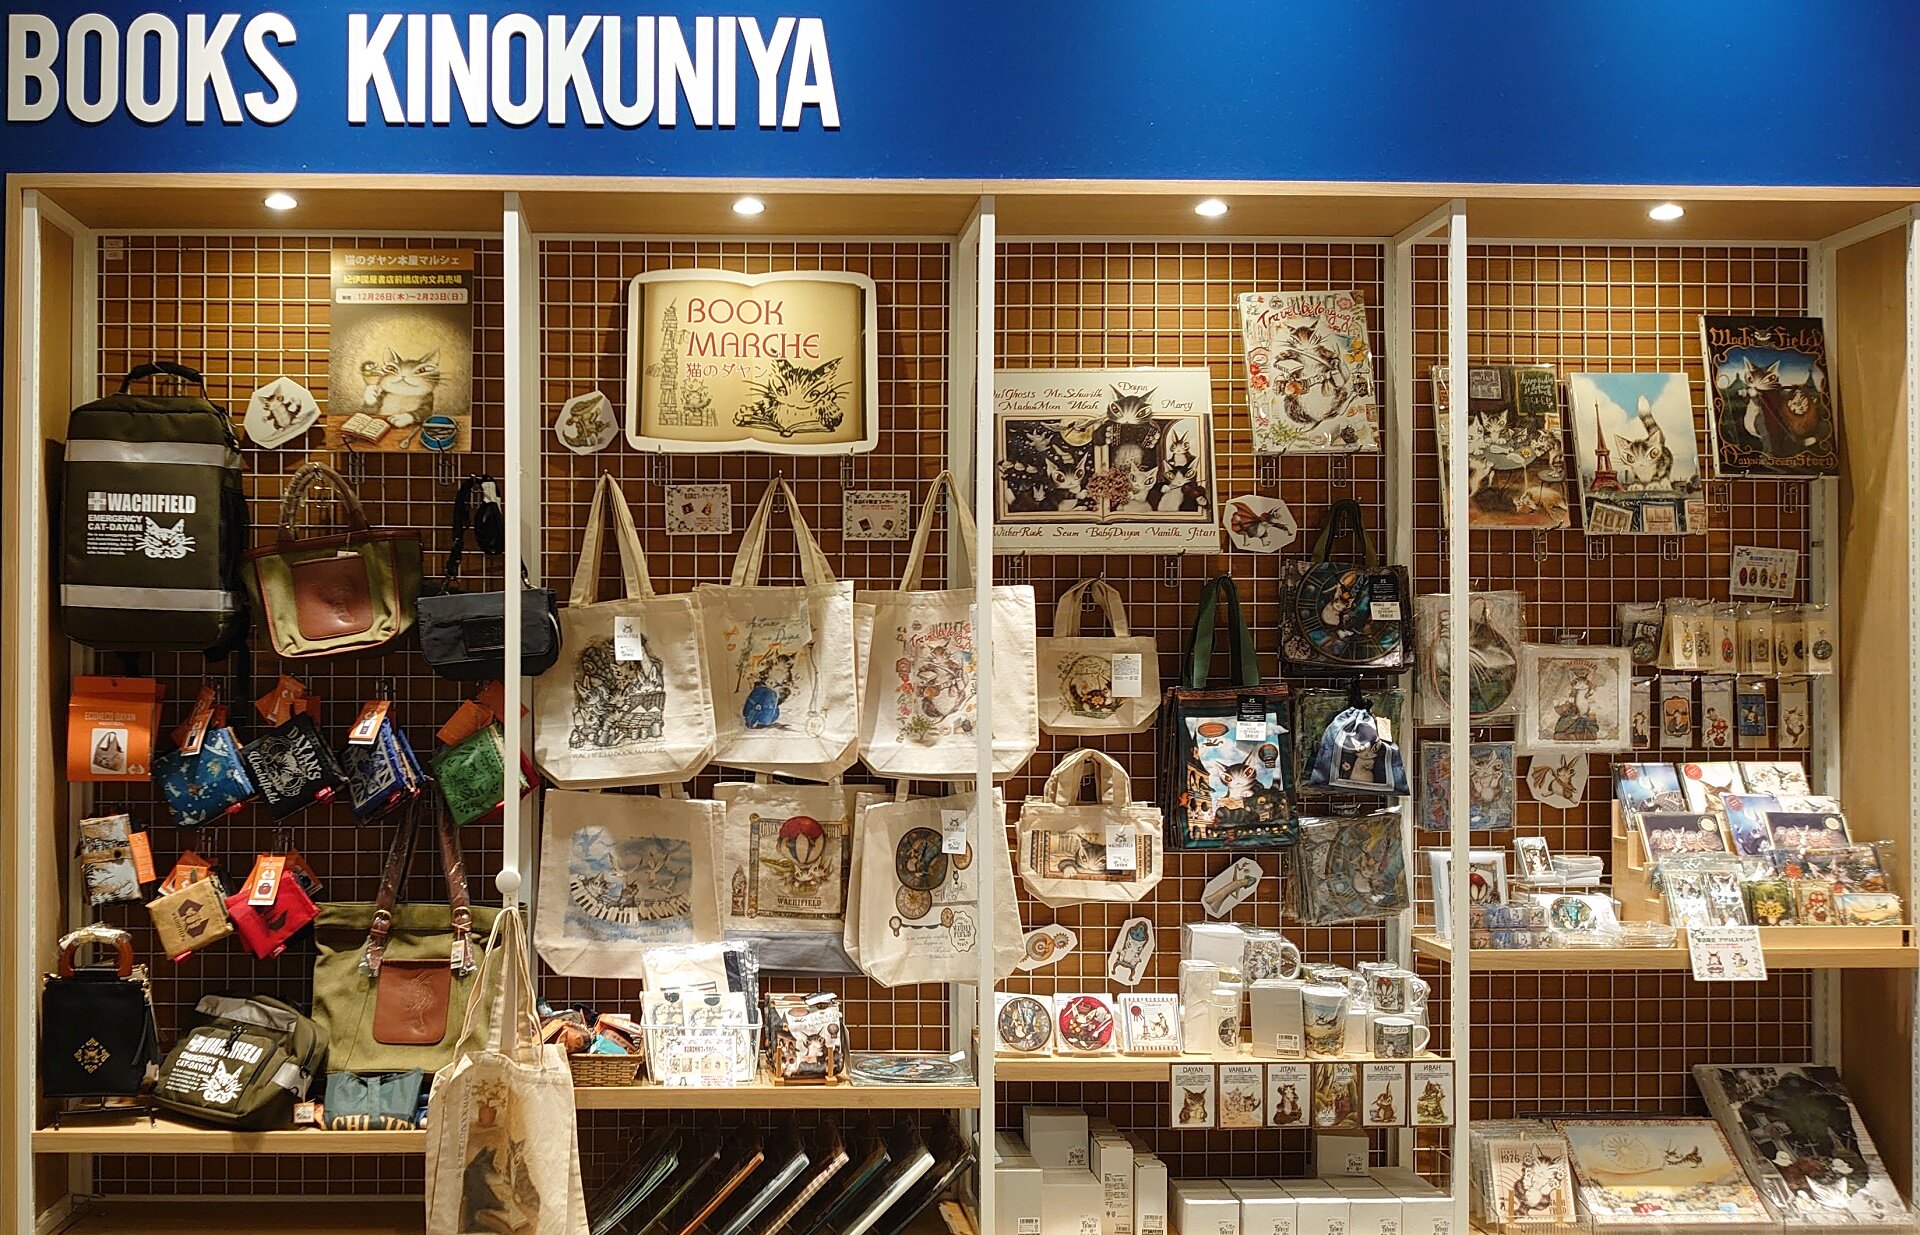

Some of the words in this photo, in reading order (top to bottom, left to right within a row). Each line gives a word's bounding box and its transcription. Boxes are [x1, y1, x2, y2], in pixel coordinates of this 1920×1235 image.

[7, 12, 298, 125] BOOKS
[348, 13, 841, 129] KINOKUNIYA
[344, 254, 460, 266] 猫のダヤン本屋マルシェ
[687, 298, 783, 325] BOOK
[687, 331, 820, 359] MARCHE
[686, 363, 768, 379] 猫のダヤン
[1118, 382, 1148, 393] Dayan
[107, 493, 196, 513] WACHIFIELD
[87, 514, 143, 523] EMERGENCY
[87, 523, 143, 531] CAT-DAYAN
[777, 898, 822, 907] WACHIFIELD
[1501, 1154, 1520, 1163] 1976
